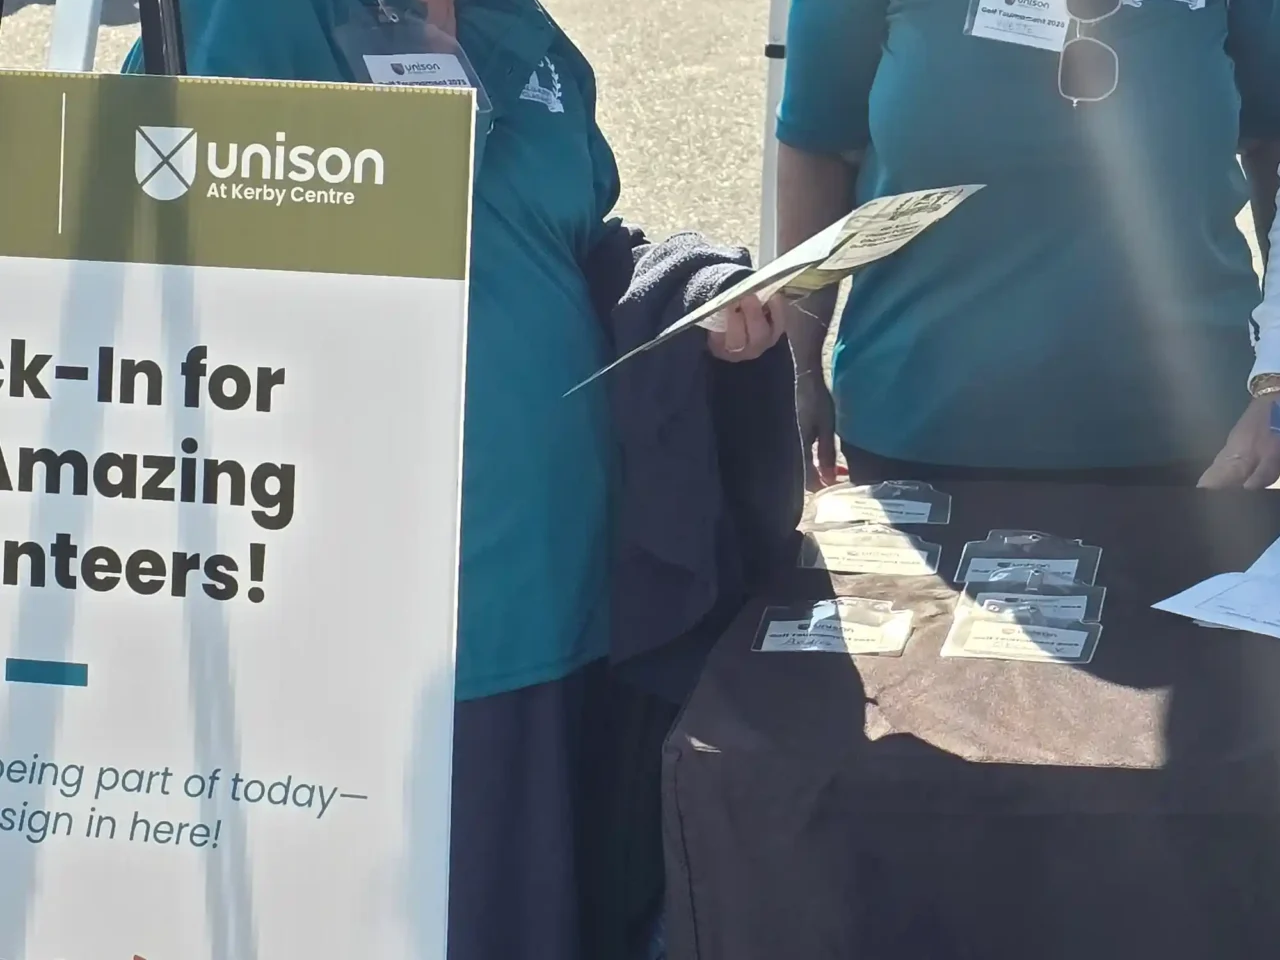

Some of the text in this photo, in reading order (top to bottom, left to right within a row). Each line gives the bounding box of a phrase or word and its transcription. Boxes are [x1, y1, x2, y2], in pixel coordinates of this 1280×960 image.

[405, 62, 440, 73] unison
[207, 131, 385, 185] unison
[206, 182, 355, 207] At Kerby Centre
[0, 338, 286, 413] k-In for
[2, 533, 266, 603] nteers!
[0, 753, 85, 798] eing
[94, 766, 173, 800] part
[184, 768, 222, 800] of
[0, 801, 222, 849] sign in here!
